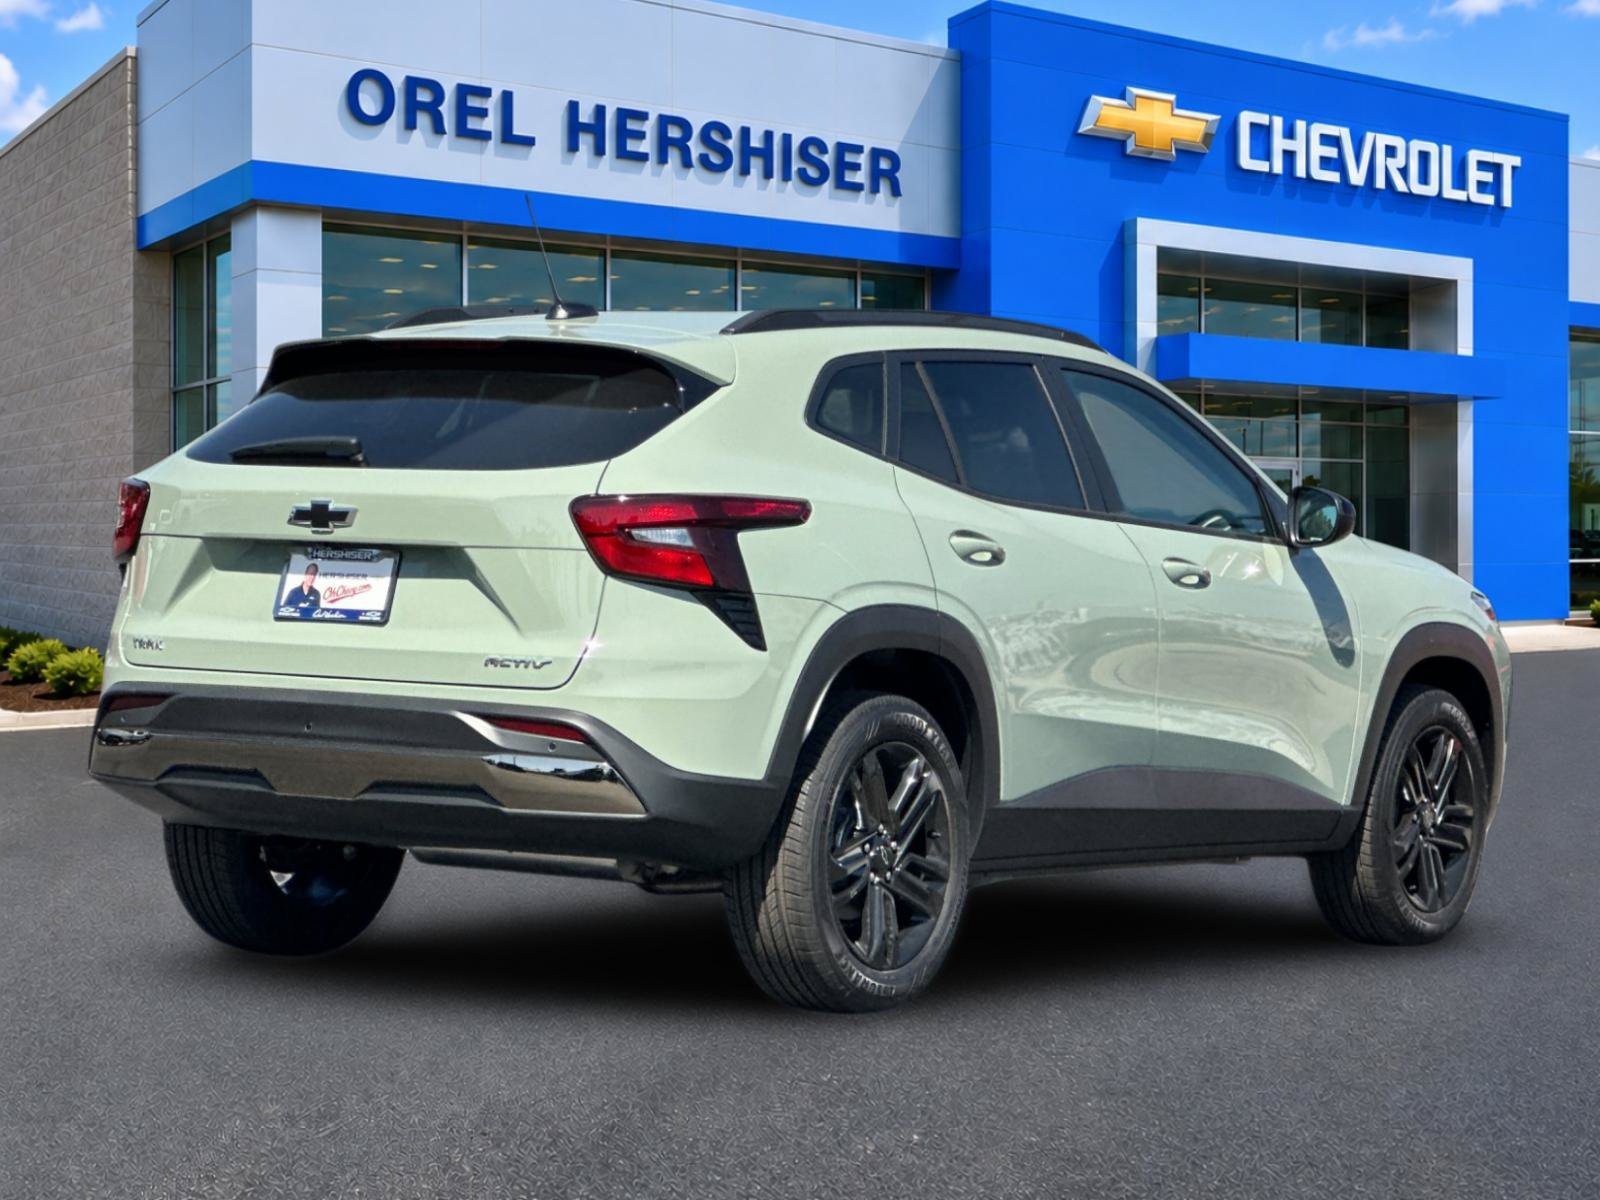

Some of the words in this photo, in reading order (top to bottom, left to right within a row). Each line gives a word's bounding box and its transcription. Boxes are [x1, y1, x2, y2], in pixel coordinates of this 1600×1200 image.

[346, 68, 536, 147] OREL
[567, 99, 903, 198] HERSHISER
[1236, 110, 1522, 208] CHEVROLET
[312, 548, 372, 560] HERSHISER
